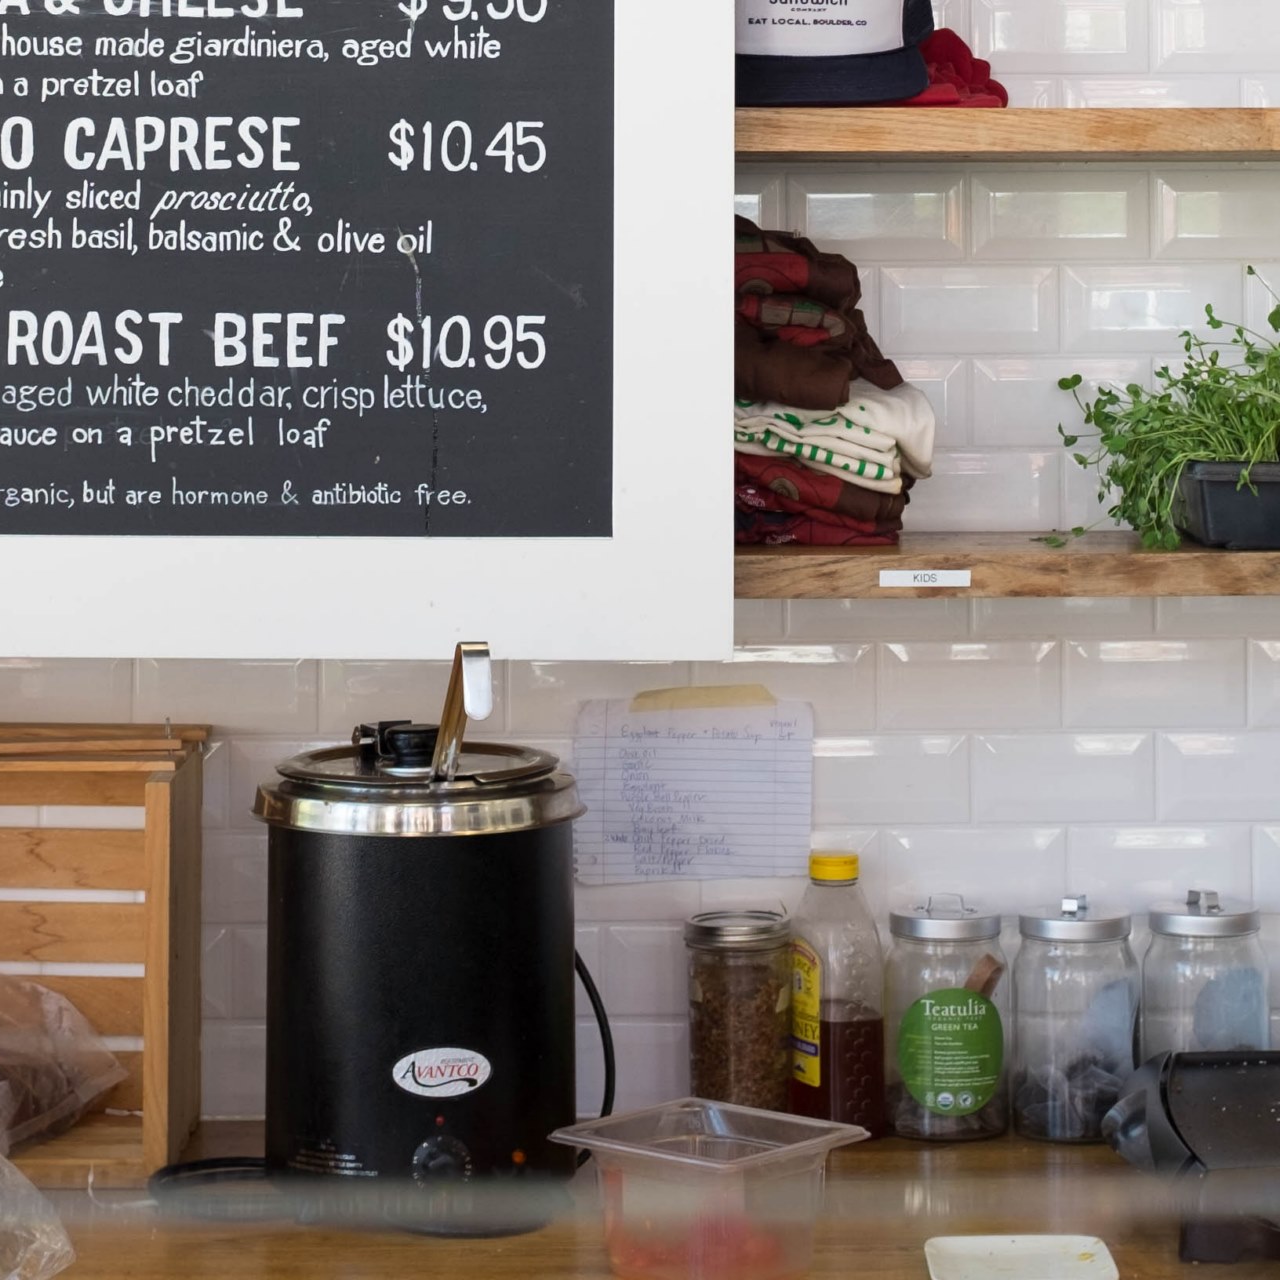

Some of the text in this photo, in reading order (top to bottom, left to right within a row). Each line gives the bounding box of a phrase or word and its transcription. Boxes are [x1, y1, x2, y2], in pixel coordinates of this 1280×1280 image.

[748, 18, 768, 26] EAT
[64, 116, 300, 171] CAPRESE
[388, 119, 546, 173] $10.45
[8, 310, 182, 365] ROAST
[212, 313, 345, 367] BEEF
[387, 313, 545, 372] $10.95
[83, 479, 115, 504] but
[126, 490, 161, 505] are
[173, 477, 268, 505] hormone
[281, 480, 298, 504] &
[312, 482, 401, 504] antibiotic
[415, 484, 470, 505] free.
[913, 574, 937, 583] KIDS
[921, 999, 985, 1016] Teatulia
[931, 1023, 978, 1031] GREEN TEA
